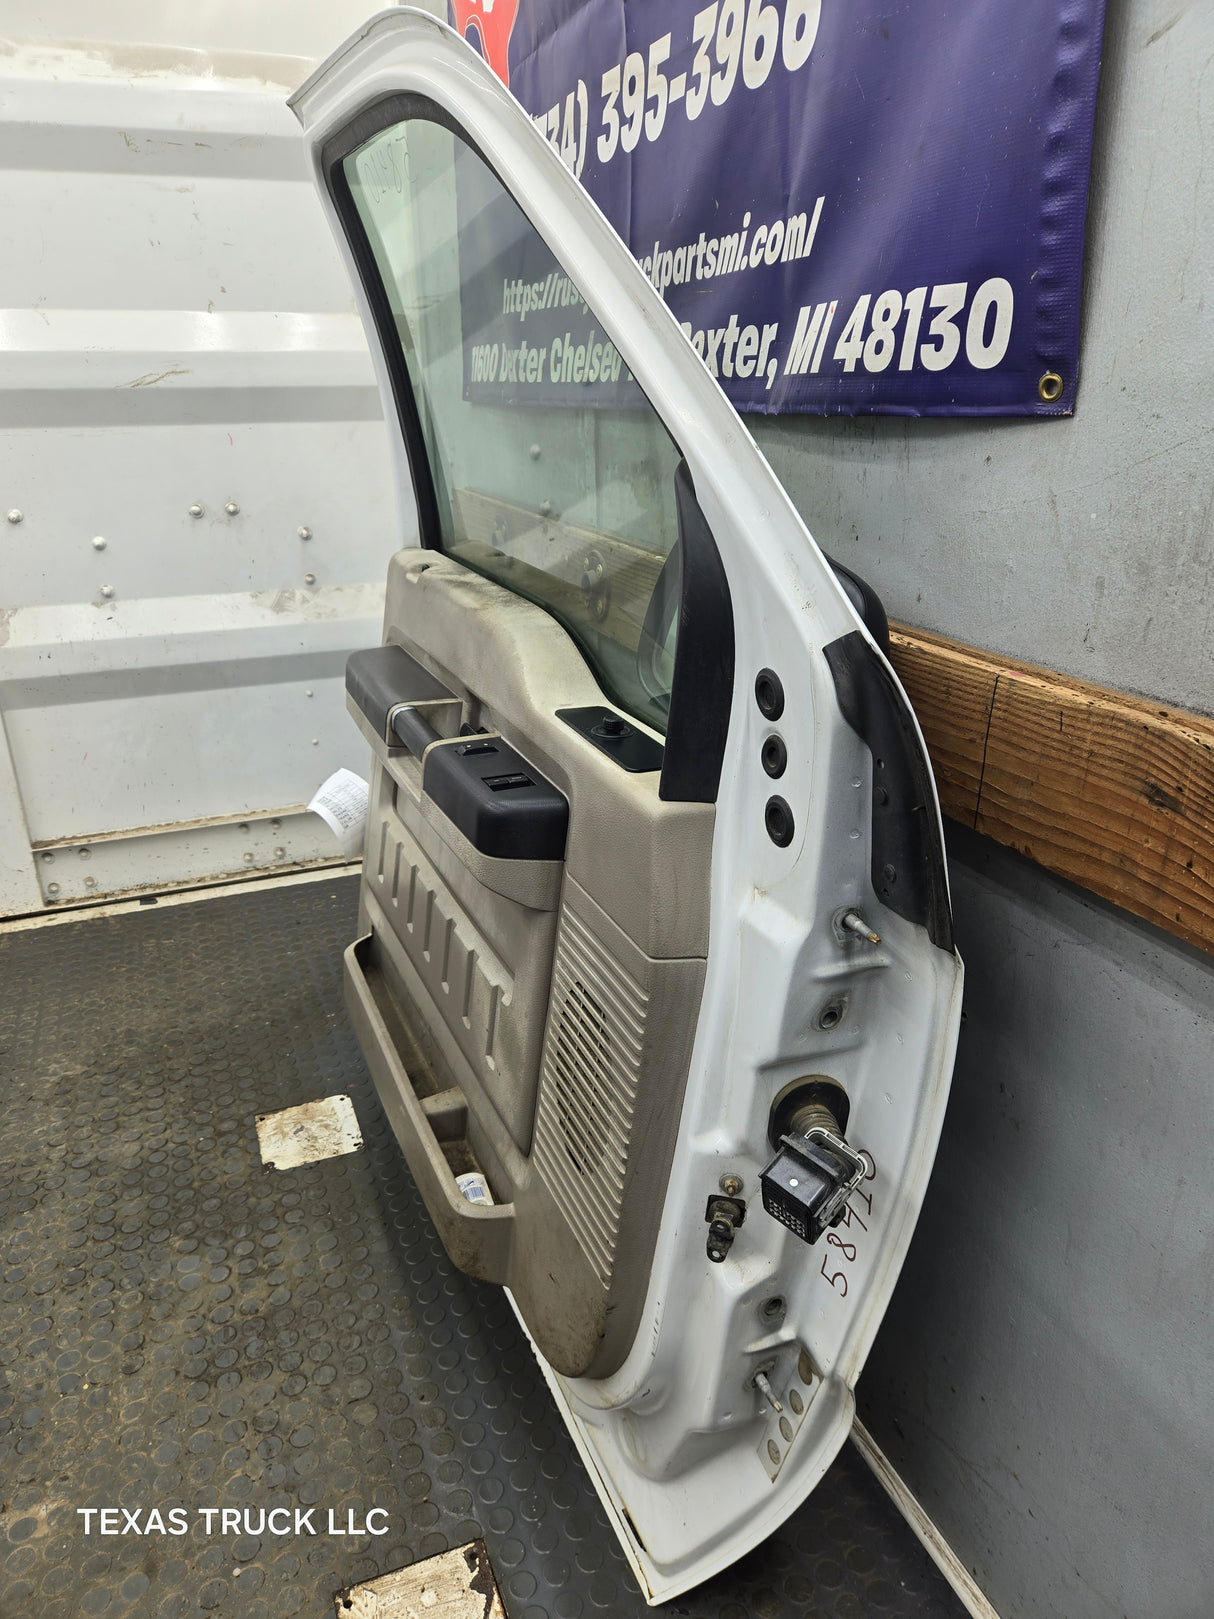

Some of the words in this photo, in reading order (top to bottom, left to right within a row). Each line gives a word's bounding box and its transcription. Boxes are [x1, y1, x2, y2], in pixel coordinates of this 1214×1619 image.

[597, 0, 822, 164] 395-3966
[471, 343, 499, 382] 11600
[499, 340, 547, 382] Dexter
[551, 330, 623, 383] Chelsea
[783, 300, 839, 376] MI
[833, 277, 1014, 373] 48130
